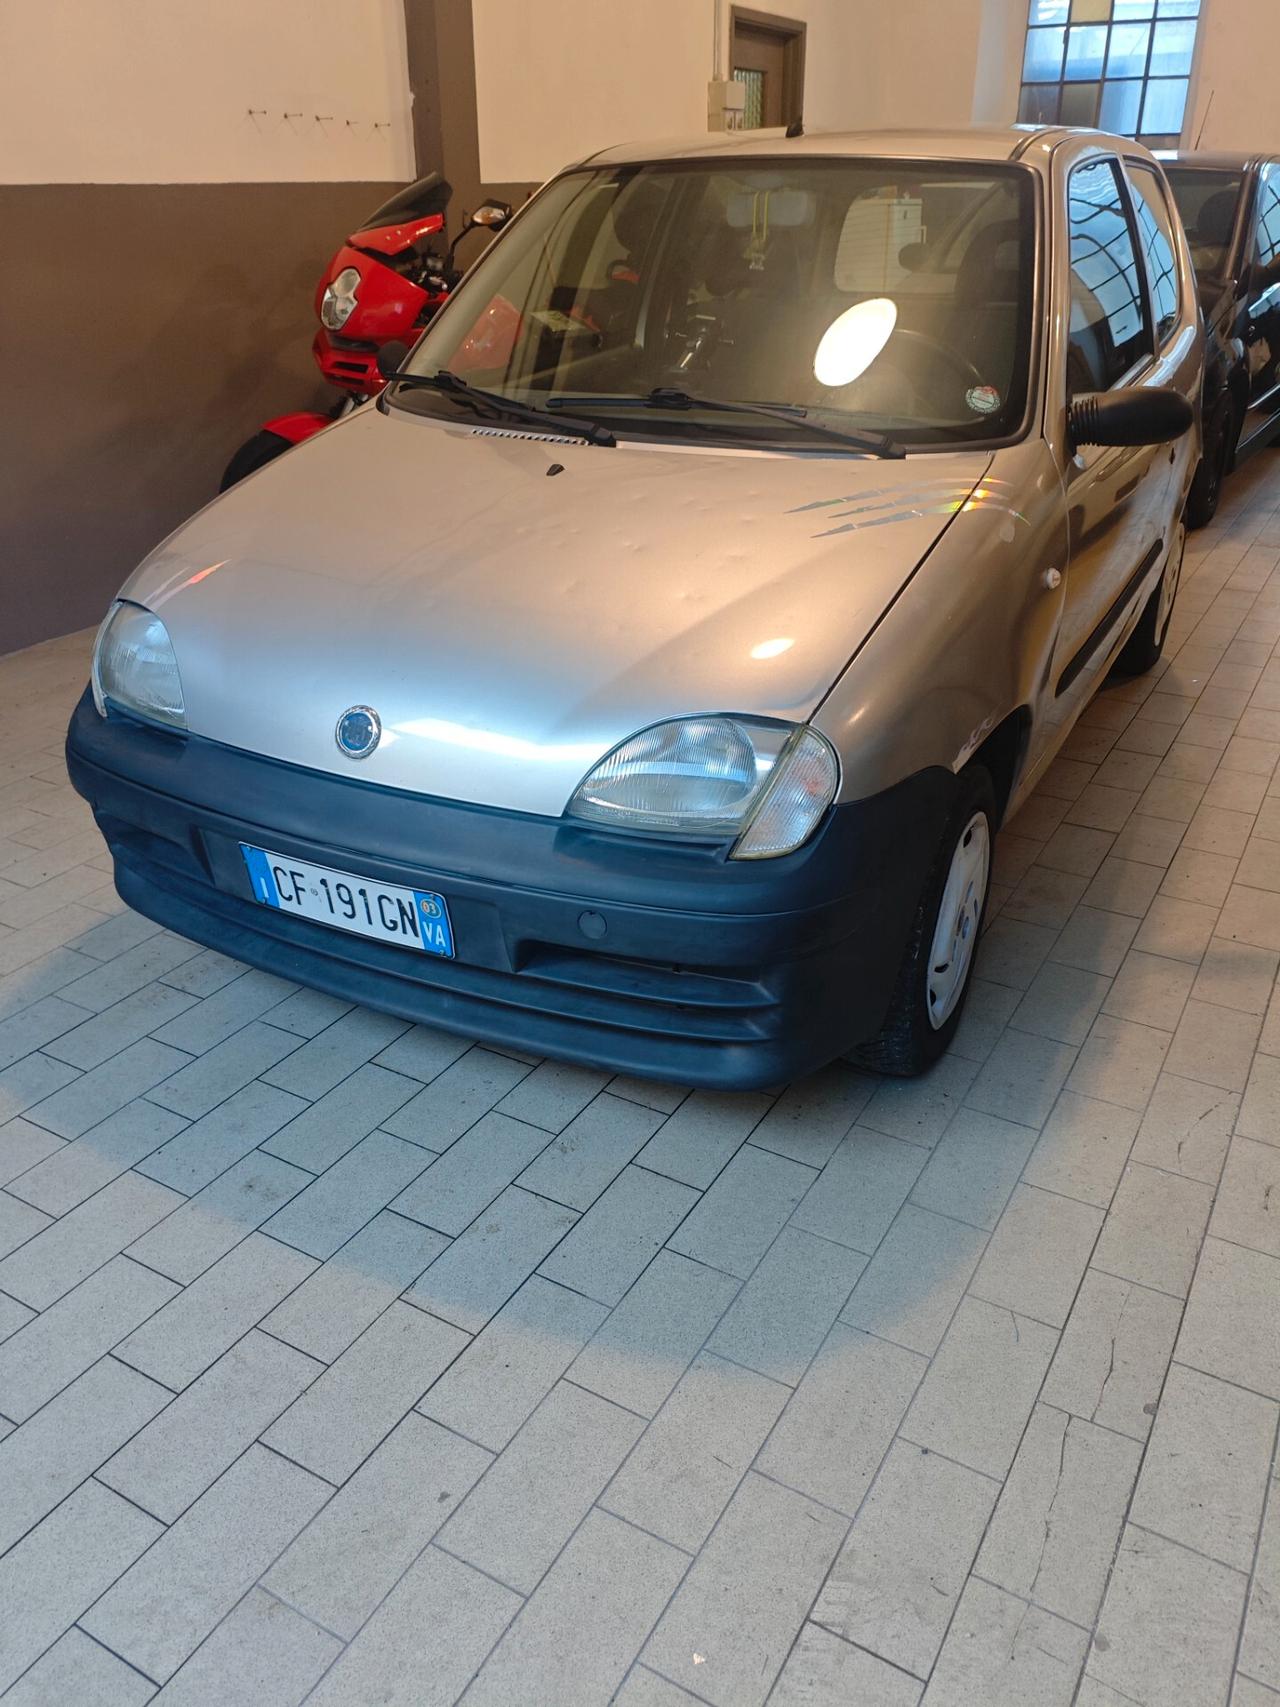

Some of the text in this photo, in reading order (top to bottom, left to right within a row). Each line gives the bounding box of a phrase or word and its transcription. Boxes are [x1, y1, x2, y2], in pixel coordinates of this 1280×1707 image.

[273, 866, 419, 937] CF 191GN
[422, 921, 446, 947] VA
